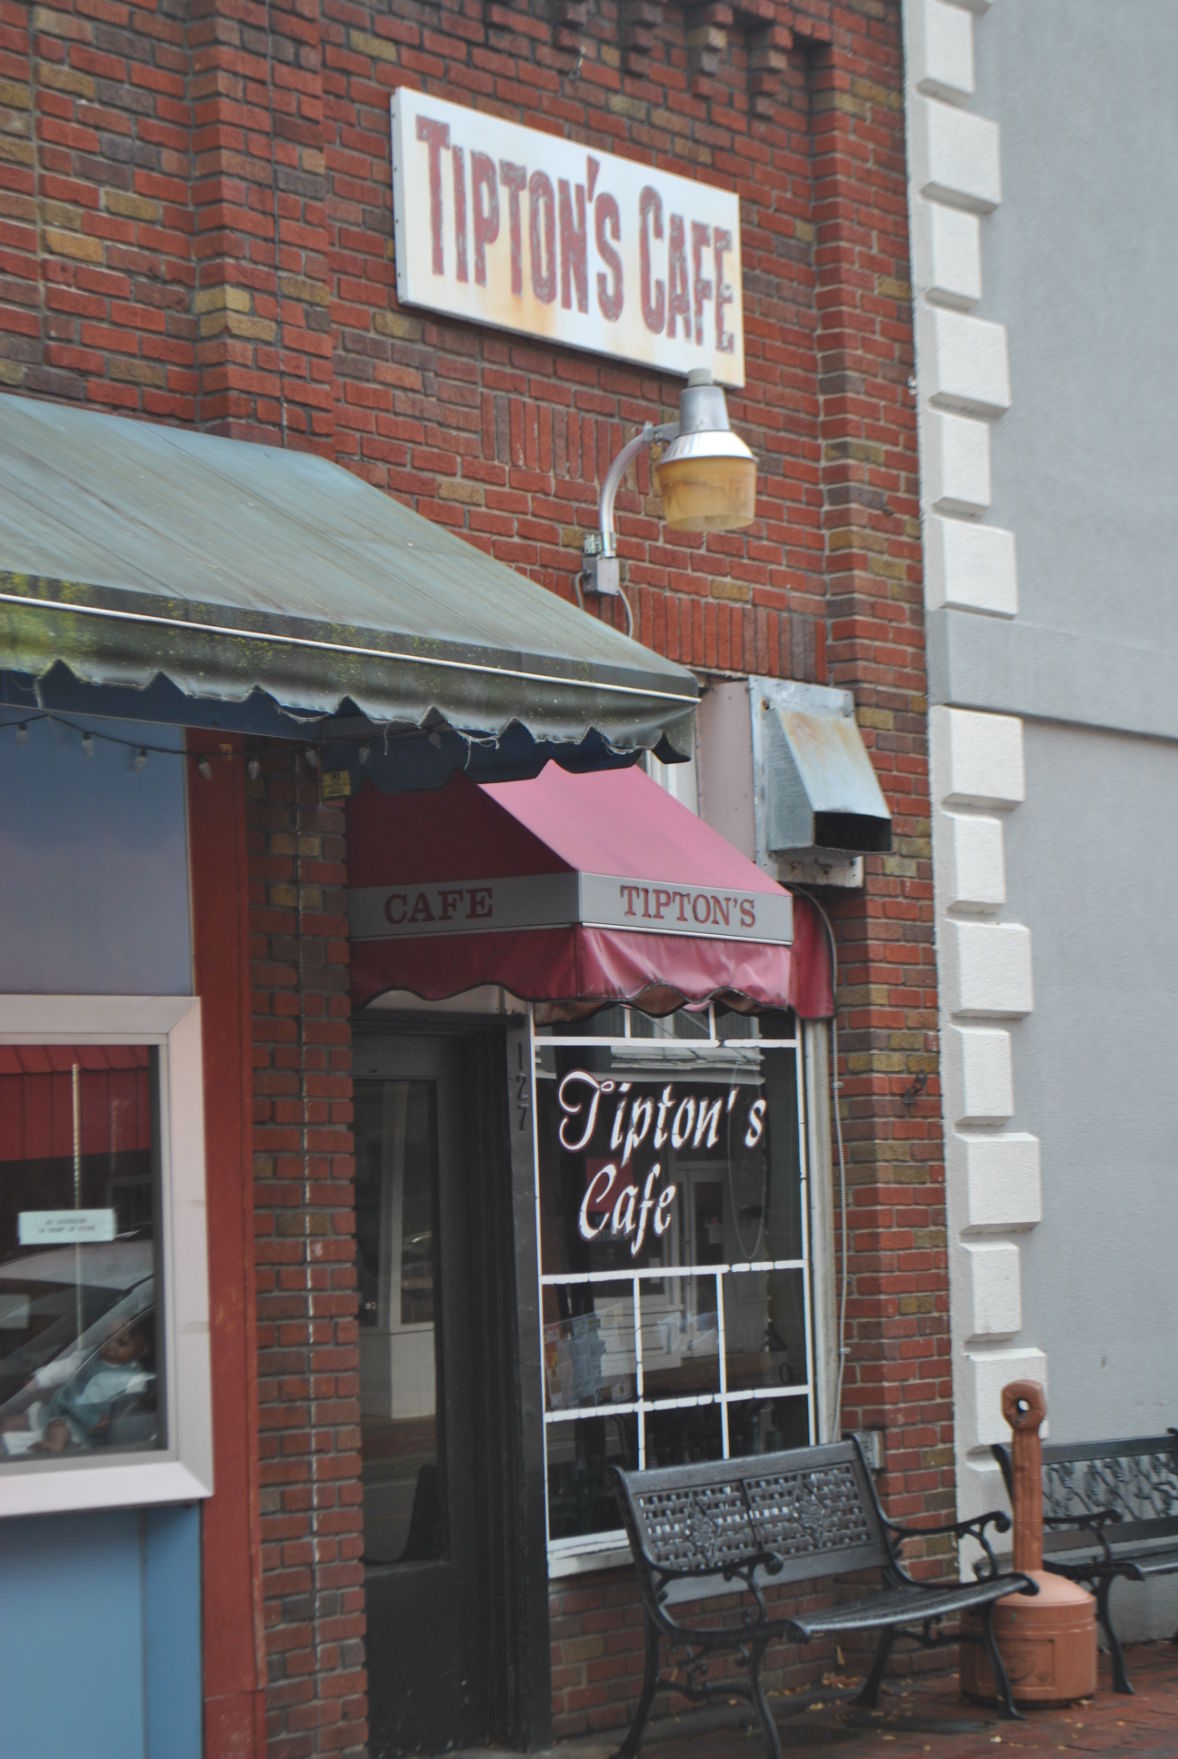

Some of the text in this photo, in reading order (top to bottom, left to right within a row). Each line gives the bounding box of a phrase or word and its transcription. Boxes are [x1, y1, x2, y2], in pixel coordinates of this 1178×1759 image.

[415, 114, 735, 355] TIPTON'S CAFE
[384, 887, 493, 925] CAFE
[620, 885, 757, 929] TIPTON'S
[516, 1041, 529, 1132] 127
[558, 1069, 767, 1168] Tipton's
[578, 1162, 677, 1259] Cafe
